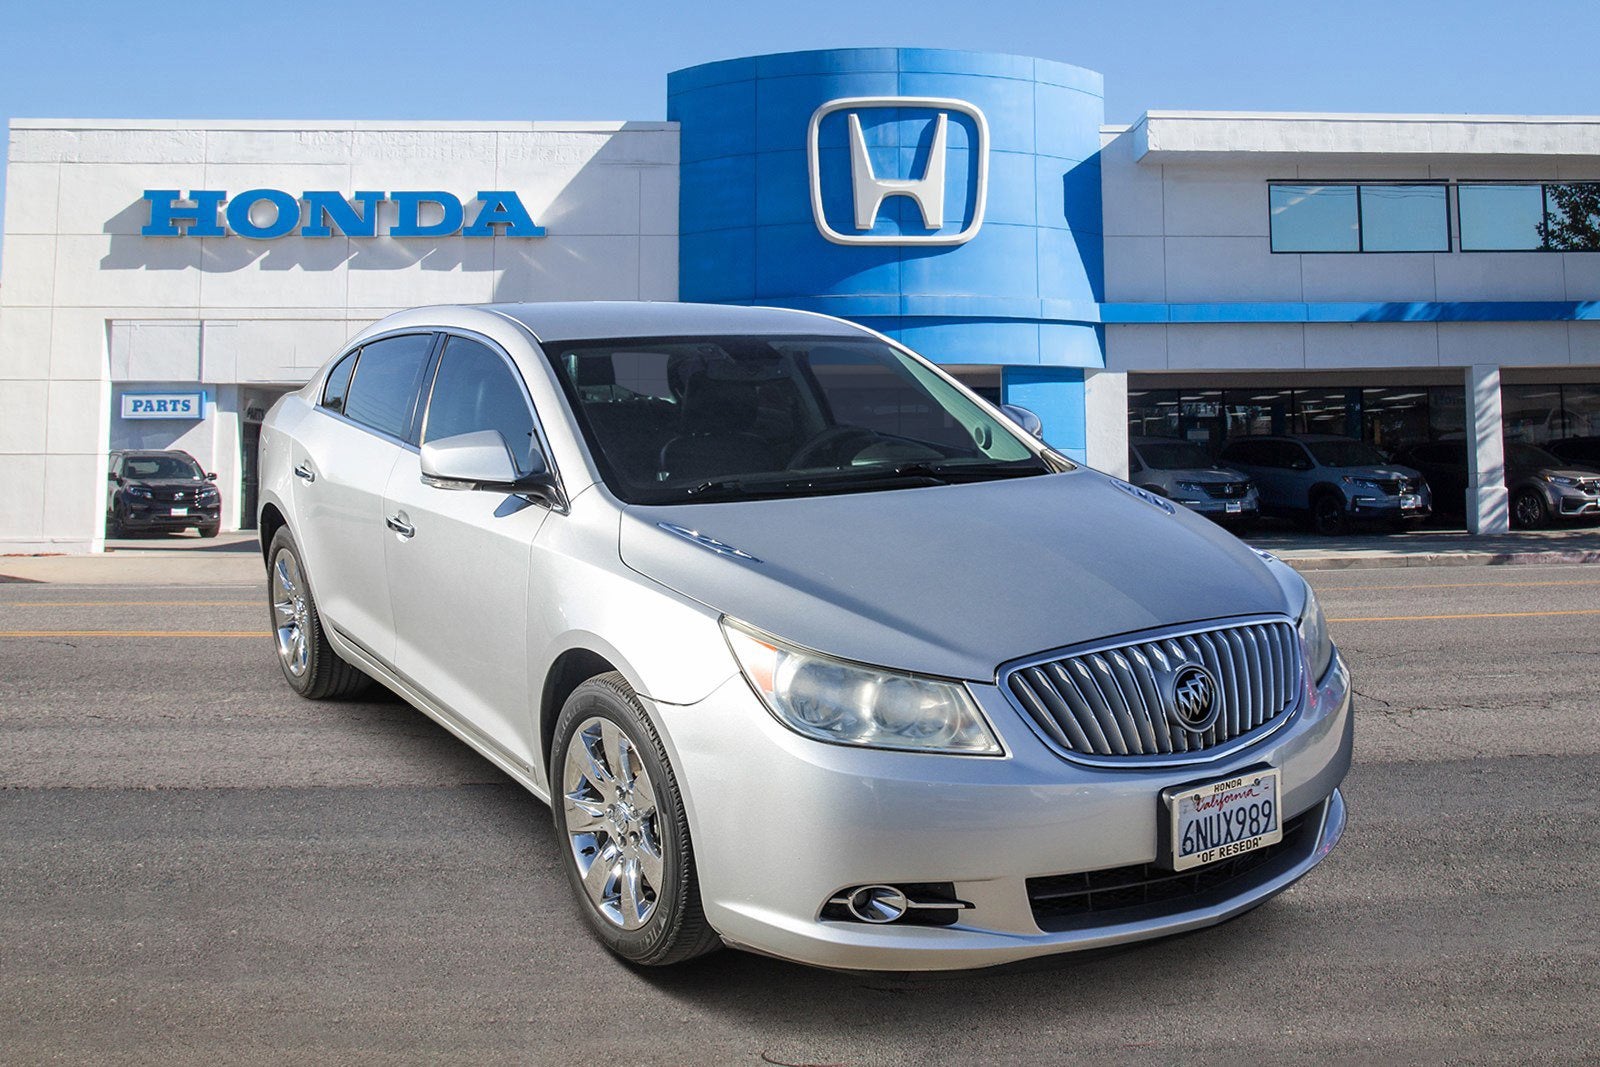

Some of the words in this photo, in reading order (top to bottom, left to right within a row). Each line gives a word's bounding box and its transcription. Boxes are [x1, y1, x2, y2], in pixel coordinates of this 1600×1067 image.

[141, 188, 548, 240] HONDA
[131, 399, 191, 412] PARTS
[1213, 778, 1242, 793] HONDA
[1193, 787, 1259, 812] California
[1181, 799, 1272, 856] 6NUX989
[1201, 849, 1215, 863] OF
[1218, 837, 1259, 859] RESEDA
